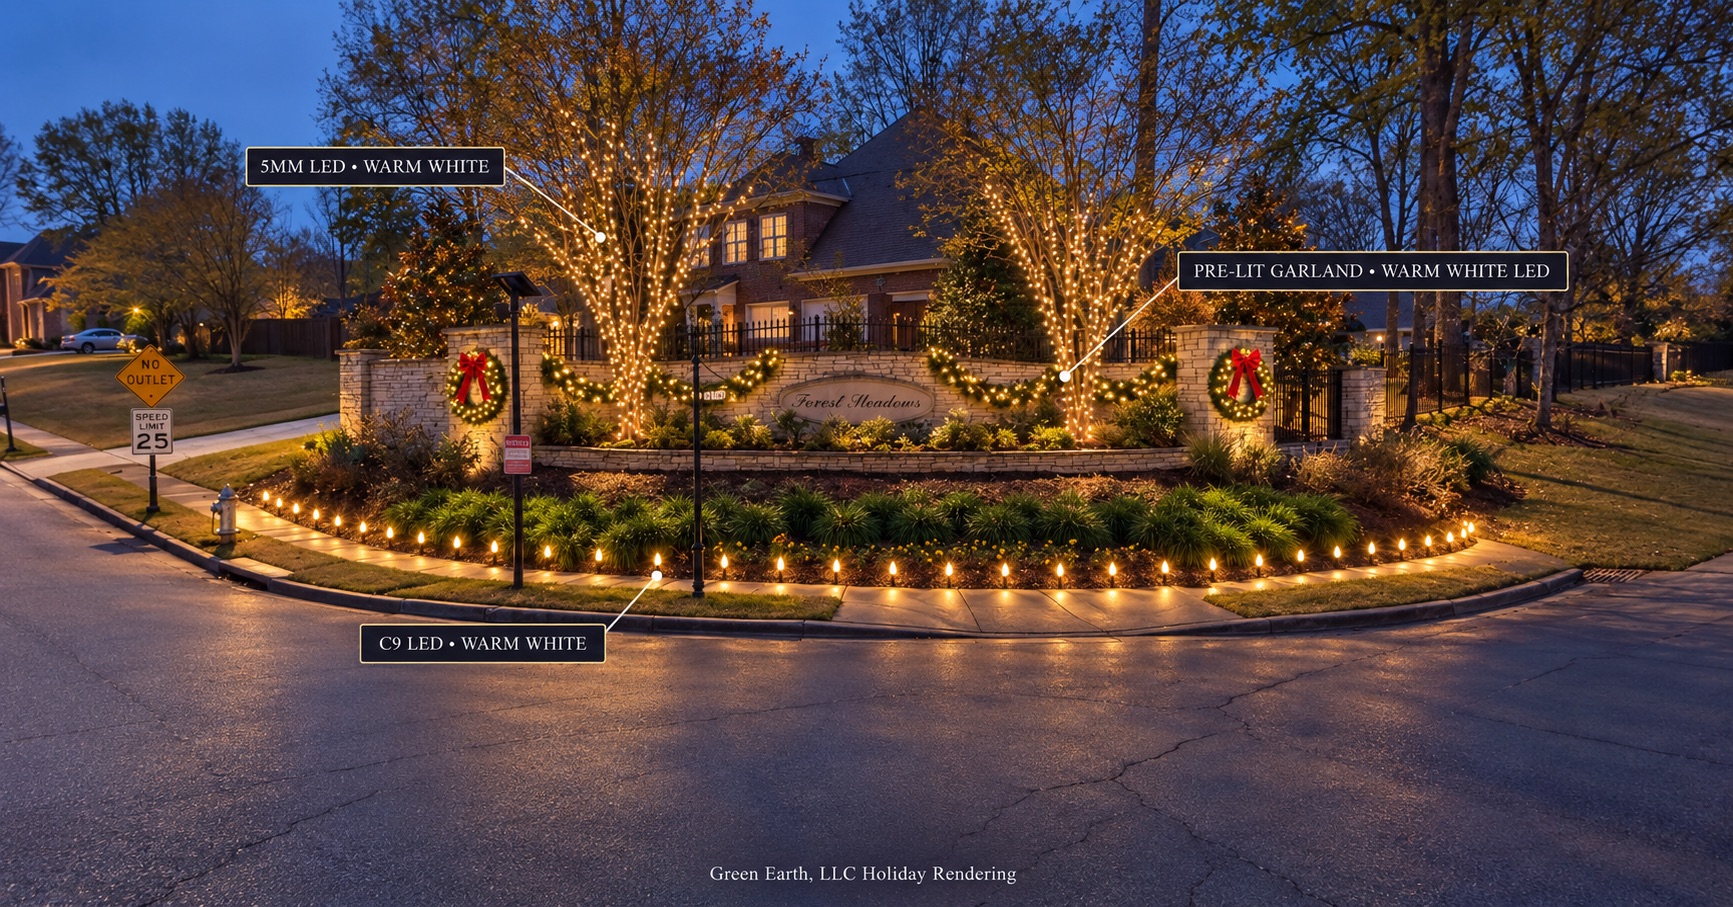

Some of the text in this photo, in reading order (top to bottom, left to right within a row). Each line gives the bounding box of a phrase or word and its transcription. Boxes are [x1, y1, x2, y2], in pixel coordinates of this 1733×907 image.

[141, 360, 160, 369] NO
[127, 374, 175, 385] OUTLET
[847, 393, 921, 408] Meadows
[135, 413, 168, 421] SPEED
[137, 433, 168, 449] 25
